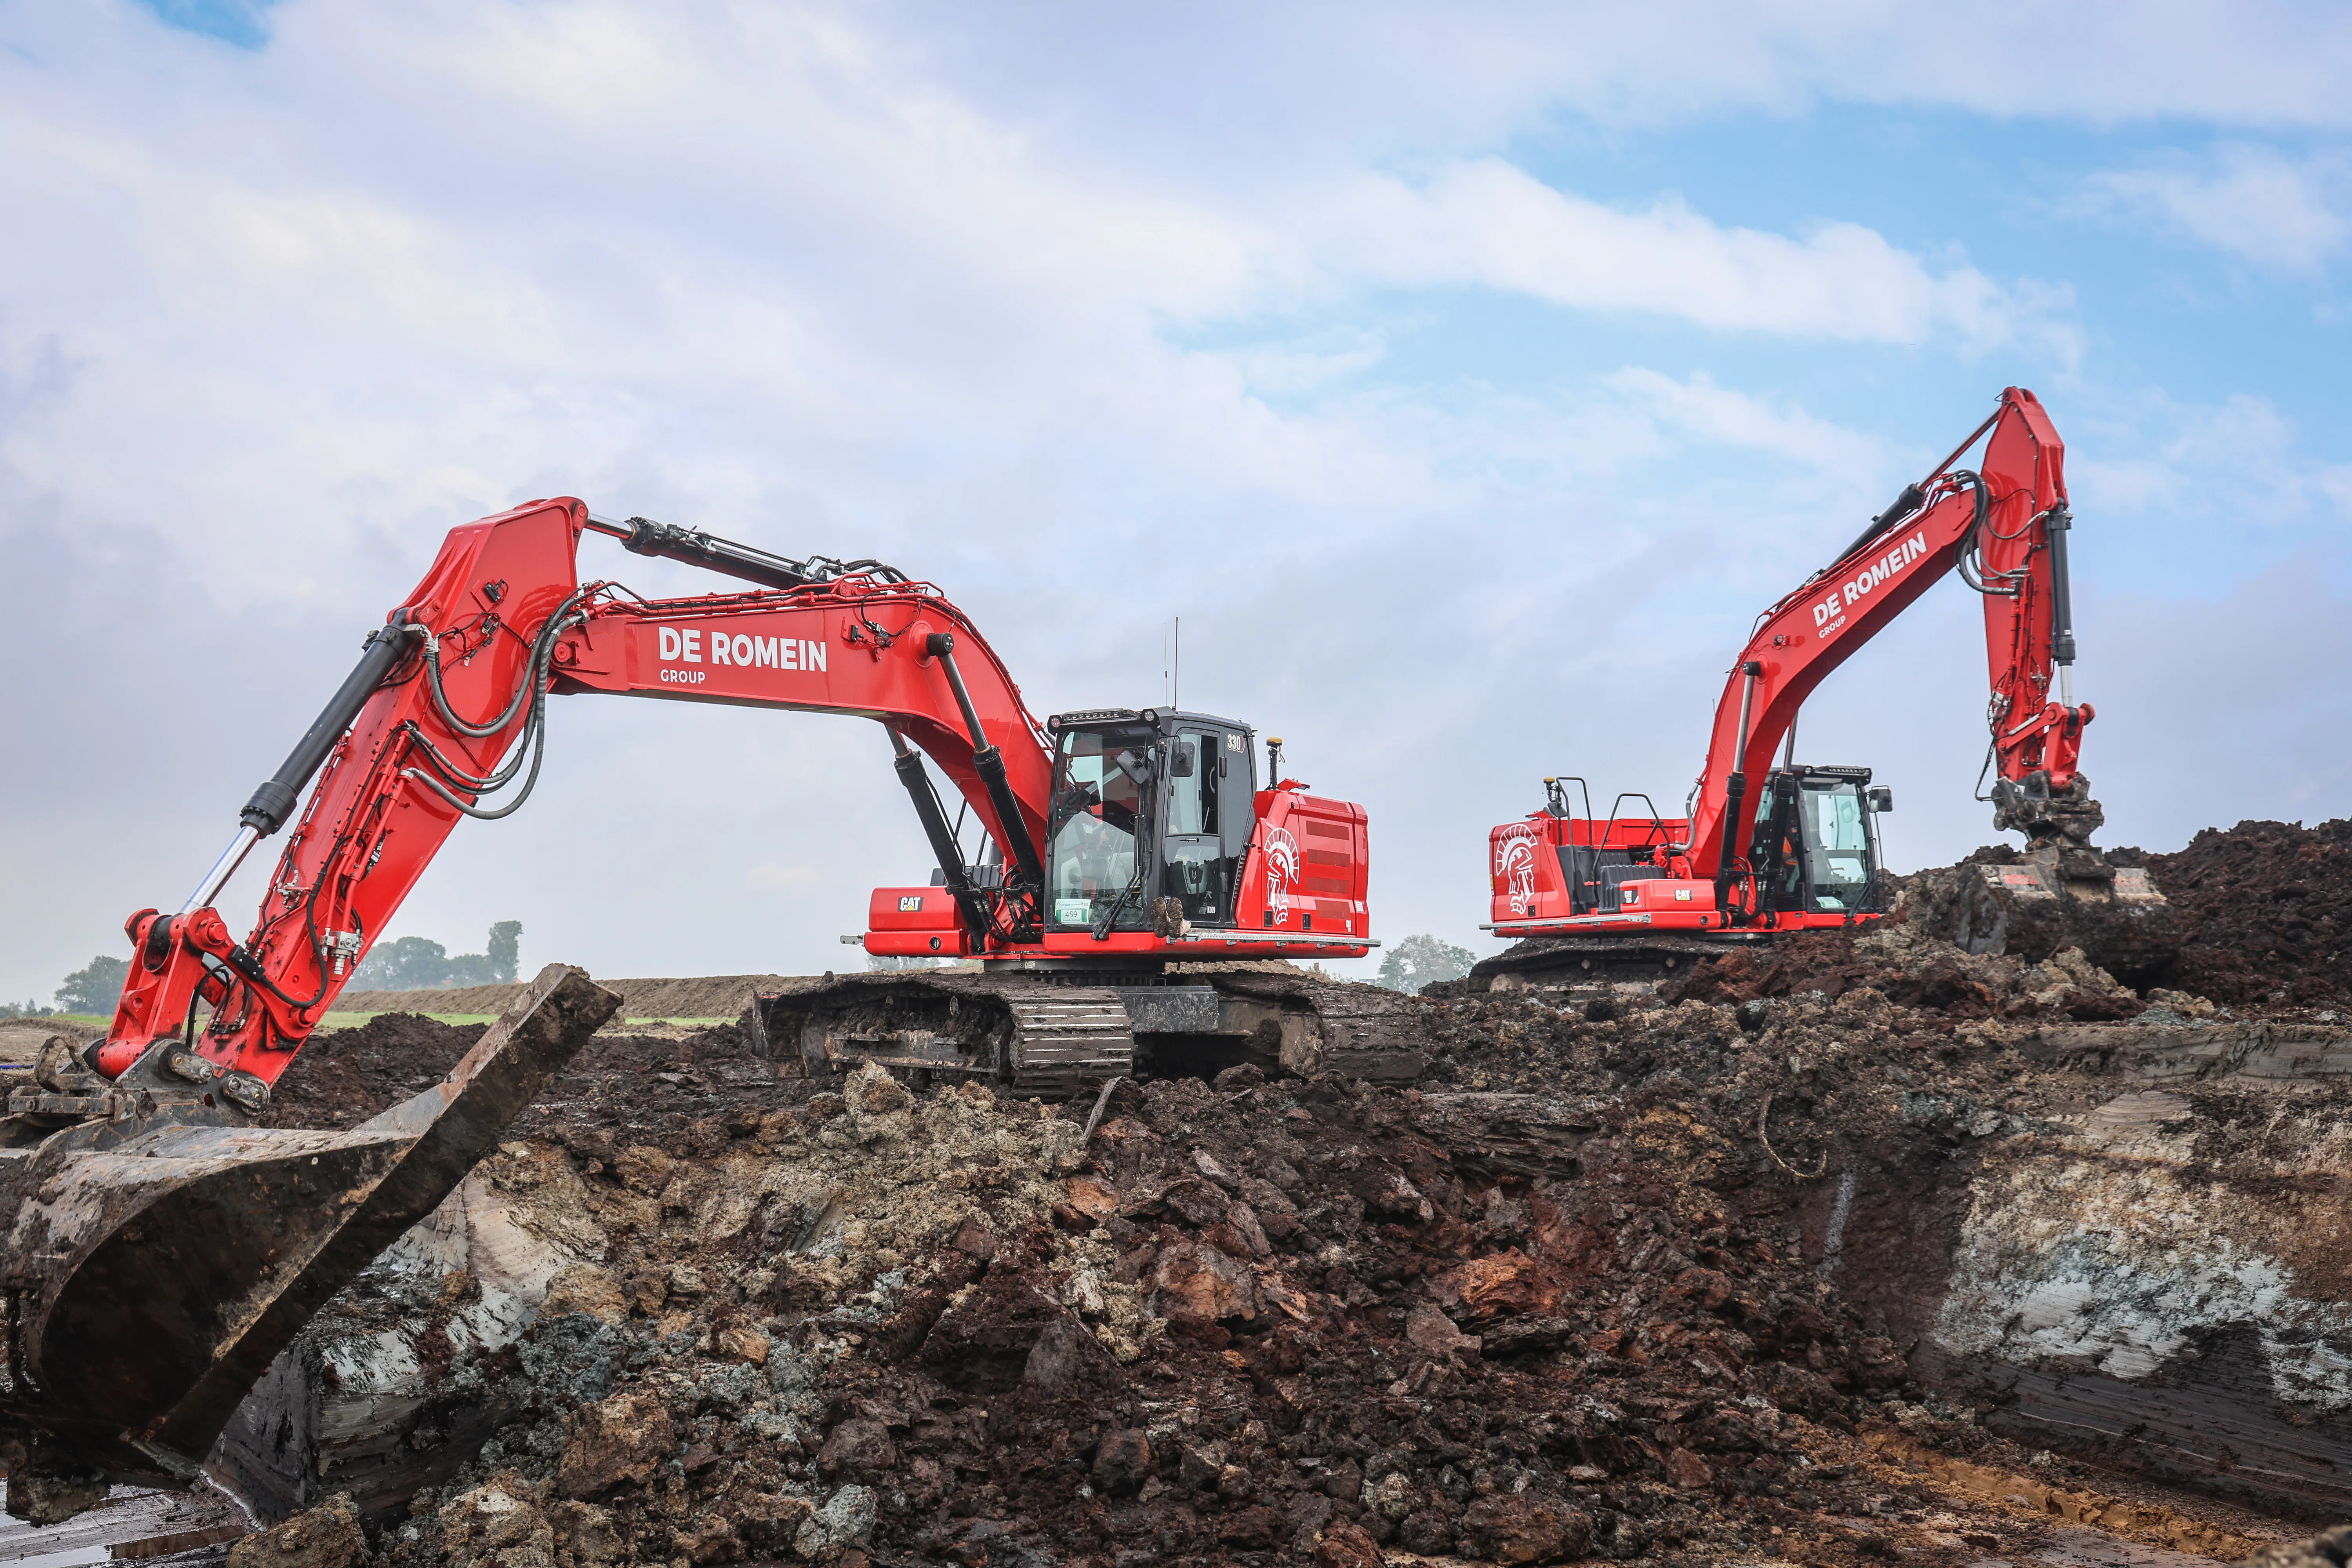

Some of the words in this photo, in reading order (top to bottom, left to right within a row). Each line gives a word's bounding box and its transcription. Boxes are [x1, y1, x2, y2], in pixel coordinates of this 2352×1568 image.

[1813, 592, 1842, 627] DE
[1843, 531, 1927, 606] ROMEIN
[1818, 615, 1846, 639] GROUP
[659, 626, 702, 663] DE
[711, 632, 827, 672] ROMEIN
[660, 669, 706, 684] GROUP
[1227, 734, 1241, 751] 330
[900, 895, 921, 911] CAT
[1675, 890, 1690, 900] CAT
